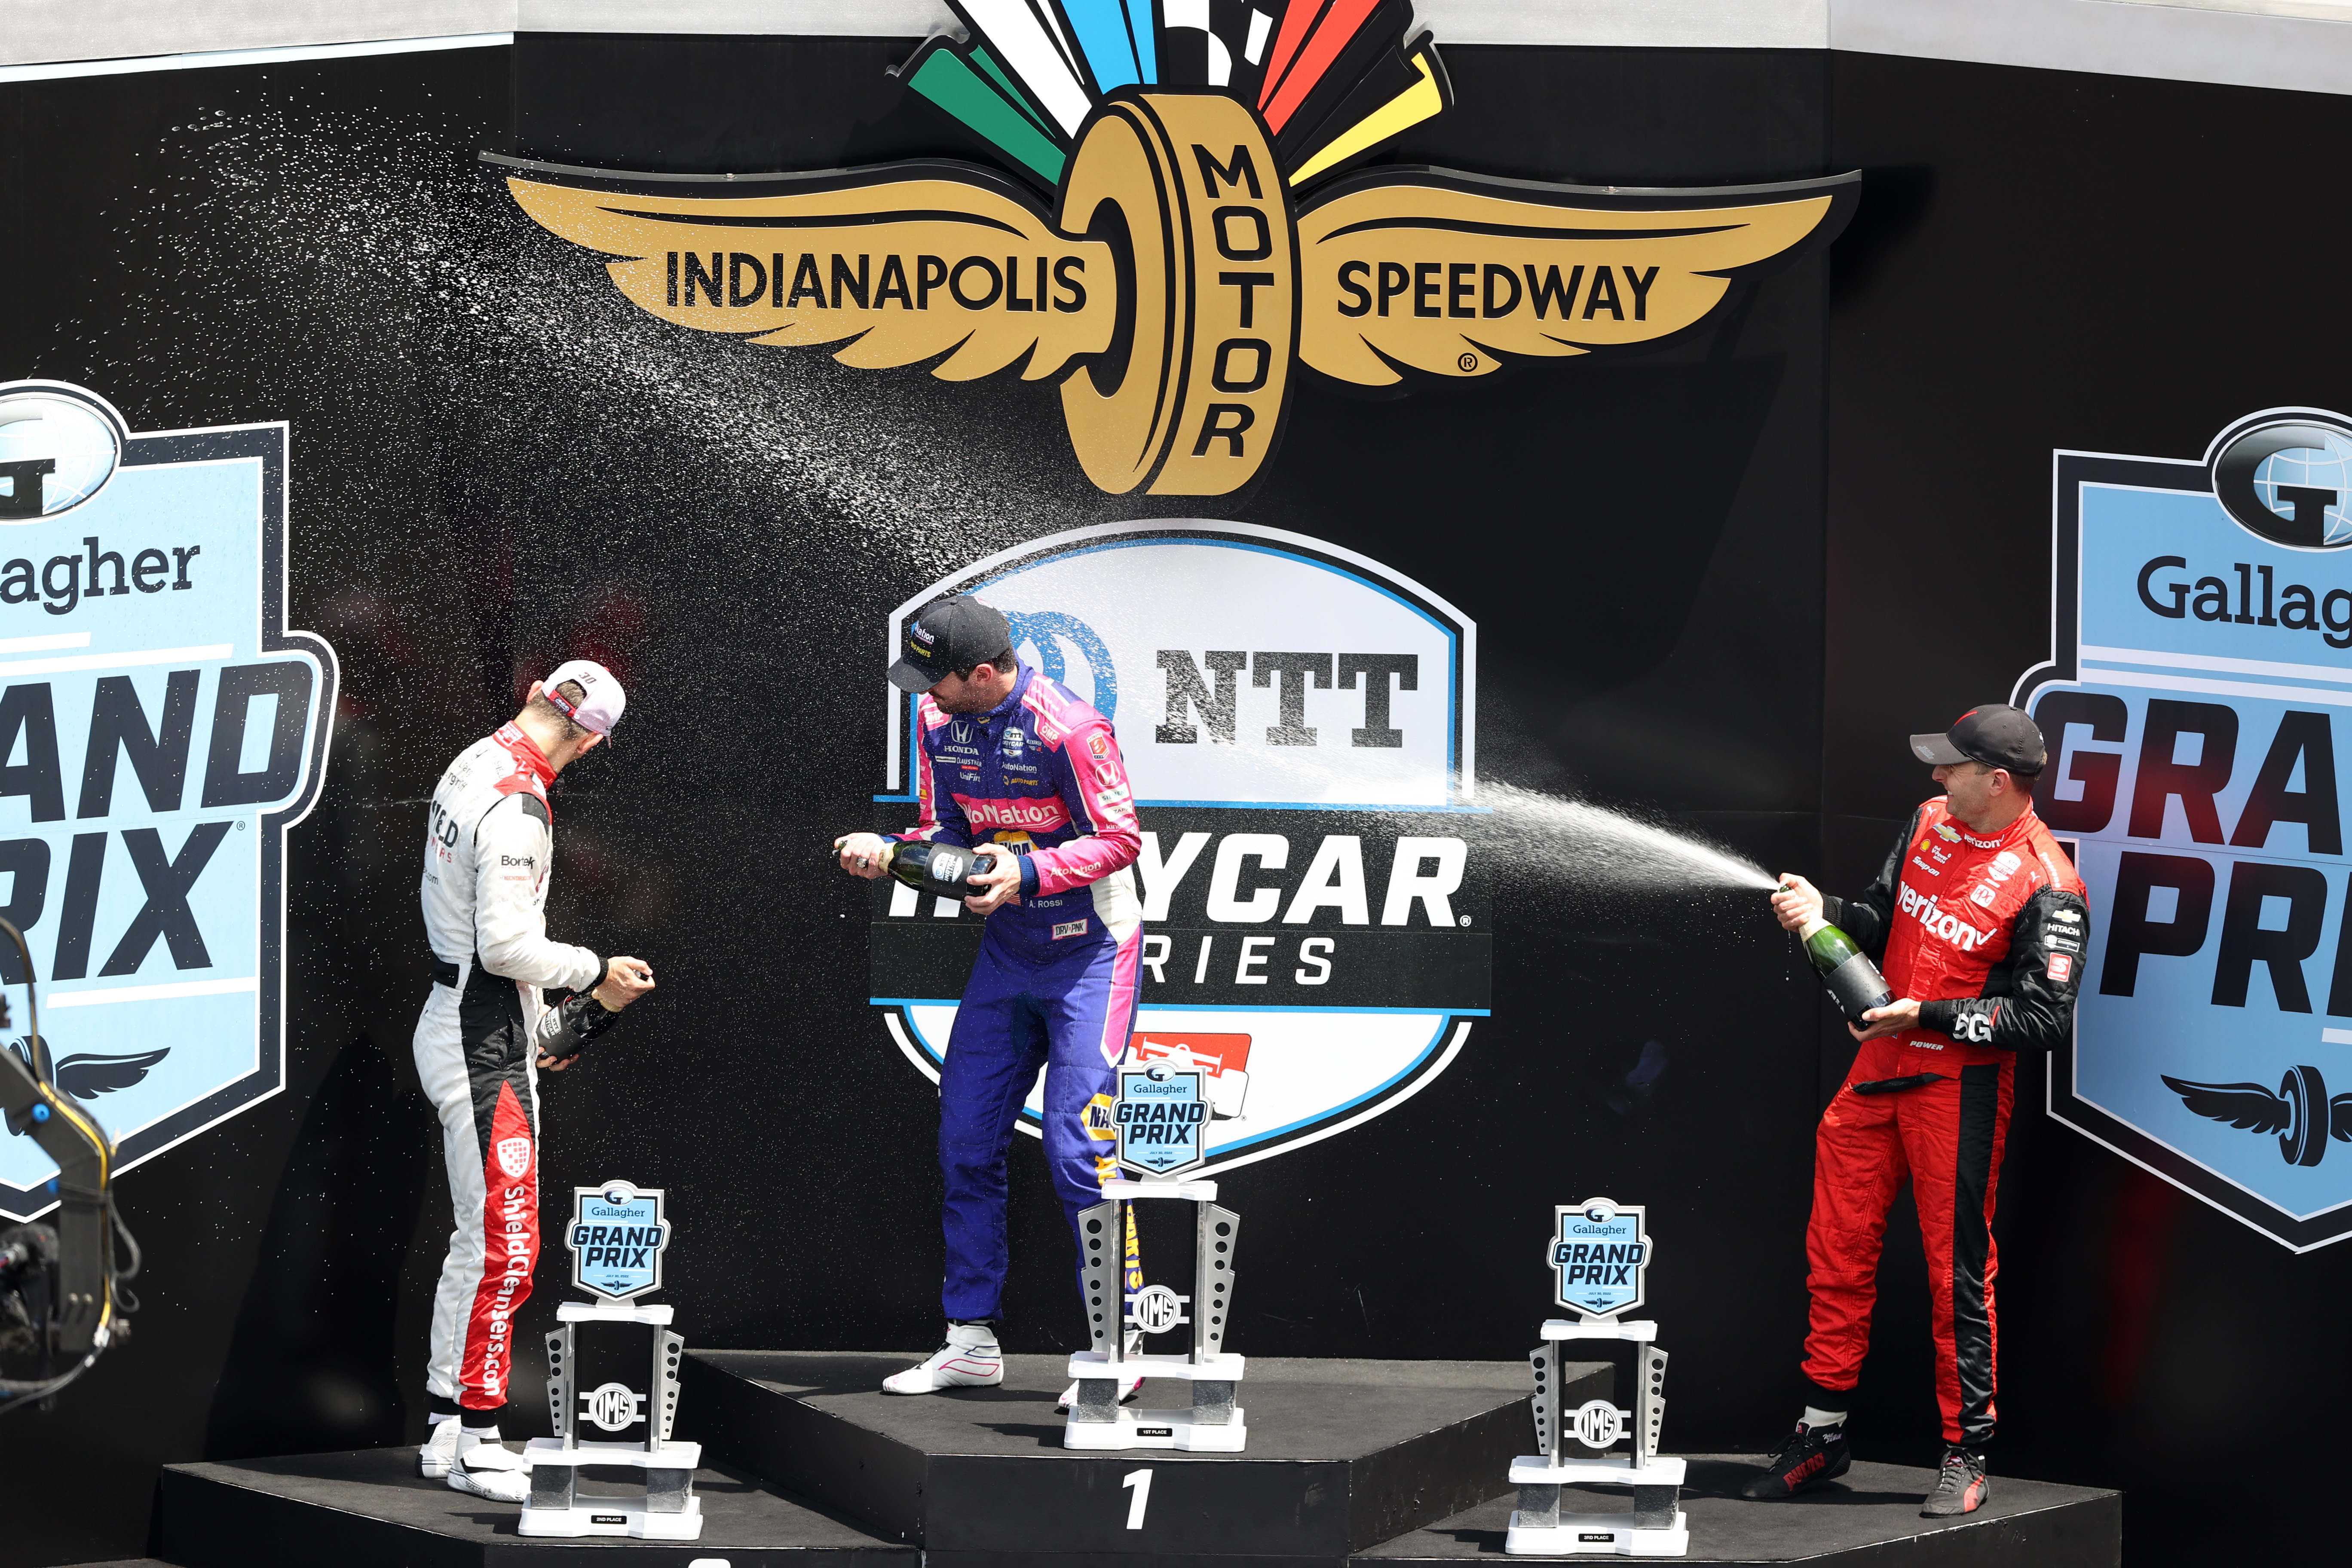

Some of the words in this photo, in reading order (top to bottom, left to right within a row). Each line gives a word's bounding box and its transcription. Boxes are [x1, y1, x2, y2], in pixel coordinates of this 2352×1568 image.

[666, 251, 1087, 313] INDIANAPOLIS
[1337, 260, 1660, 322] SPEEDWAY
[1191, 144, 1274, 457] MOTOR
[578, 672, 597, 684] 30
[1155, 649, 1418, 748] NTT
[1041, 724, 1059, 741] OMP
[944, 745, 980, 756] HONDA
[1002, 761, 1038, 772] AutoNation
[1964, 833, 2000, 849] verizon
[501, 855, 536, 869] Bortek
[1029, 900, 1036, 908] A.
[1038, 899, 1063, 908] ROSSI
[1897, 880, 1977, 952] verizon
[1056, 926, 1069, 935] DRV
[1071, 922, 1084, 933] PNK
[1142, 935, 1335, 985] RIES
[1952, 1013, 1992, 1042] 5G
[1910, 1040, 1944, 1050] POWER
[1133, 1084, 1188, 1095] Gallagher
[1116, 1103, 1204, 1123] GRAND
[1129, 1124, 1192, 1145] PRIX
[591, 1207, 646, 1219] Gallagher
[573, 1226, 662, 1246] GRAND
[1573, 1225, 1627, 1236] Gallagher
[585, 1247, 650, 1268] PRIX
[1555, 1244, 1644, 1264] GRAND
[1568, 1265, 1631, 1285] PRIX
[1143, 1293, 1173, 1326] IMS
[596, 1392, 629, 1424] IMS
[1583, 1409, 1615, 1441] IMS
[1122, 1469, 1153, 1530] 1
